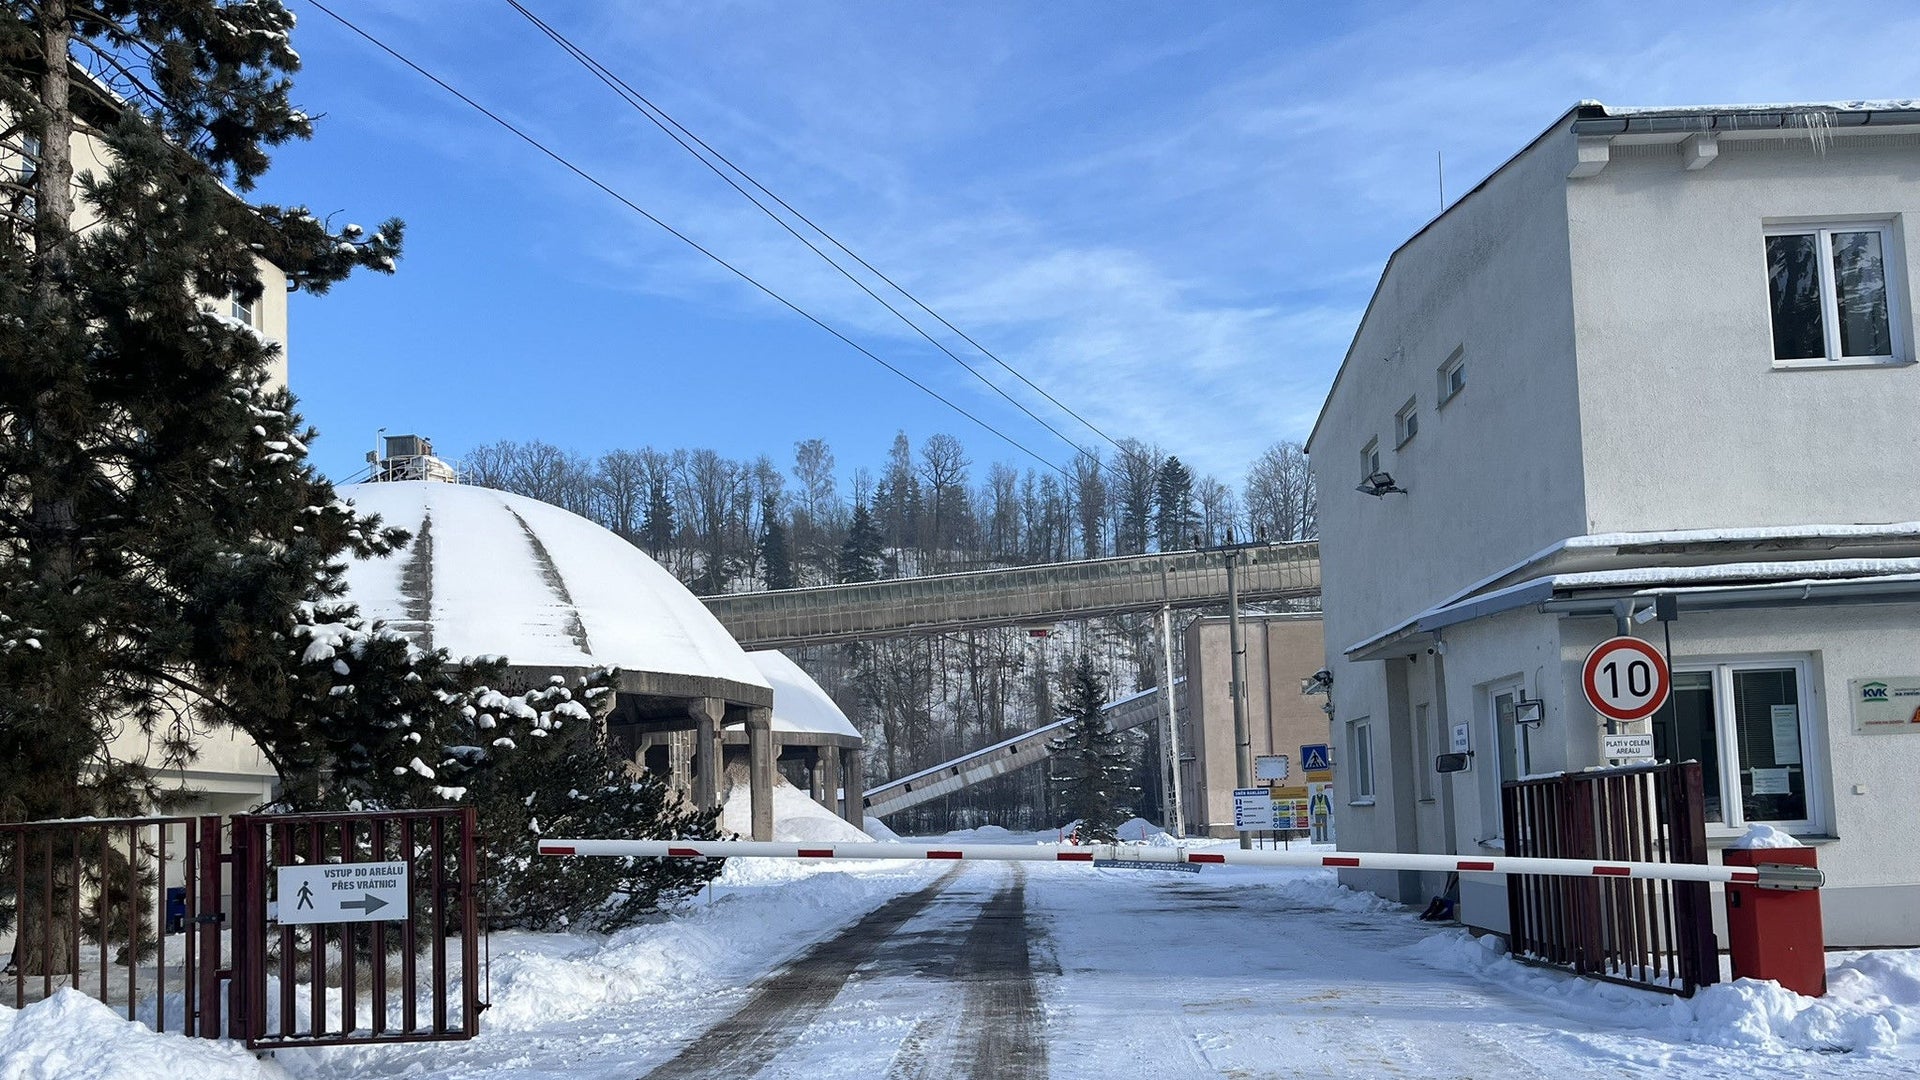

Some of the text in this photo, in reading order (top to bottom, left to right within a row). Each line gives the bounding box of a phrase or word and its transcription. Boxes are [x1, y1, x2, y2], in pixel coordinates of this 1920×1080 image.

[1603, 660, 1651, 699] 10
[1863, 688, 1888, 698] KVK
[1606, 740, 1623, 748] PLATÍ
[1628, 739, 1650, 747] CELÉM
[324, 865, 404, 878] VSTUP DO AREÁLU
[331, 879, 397, 890] PŘES VRÁTNICI
